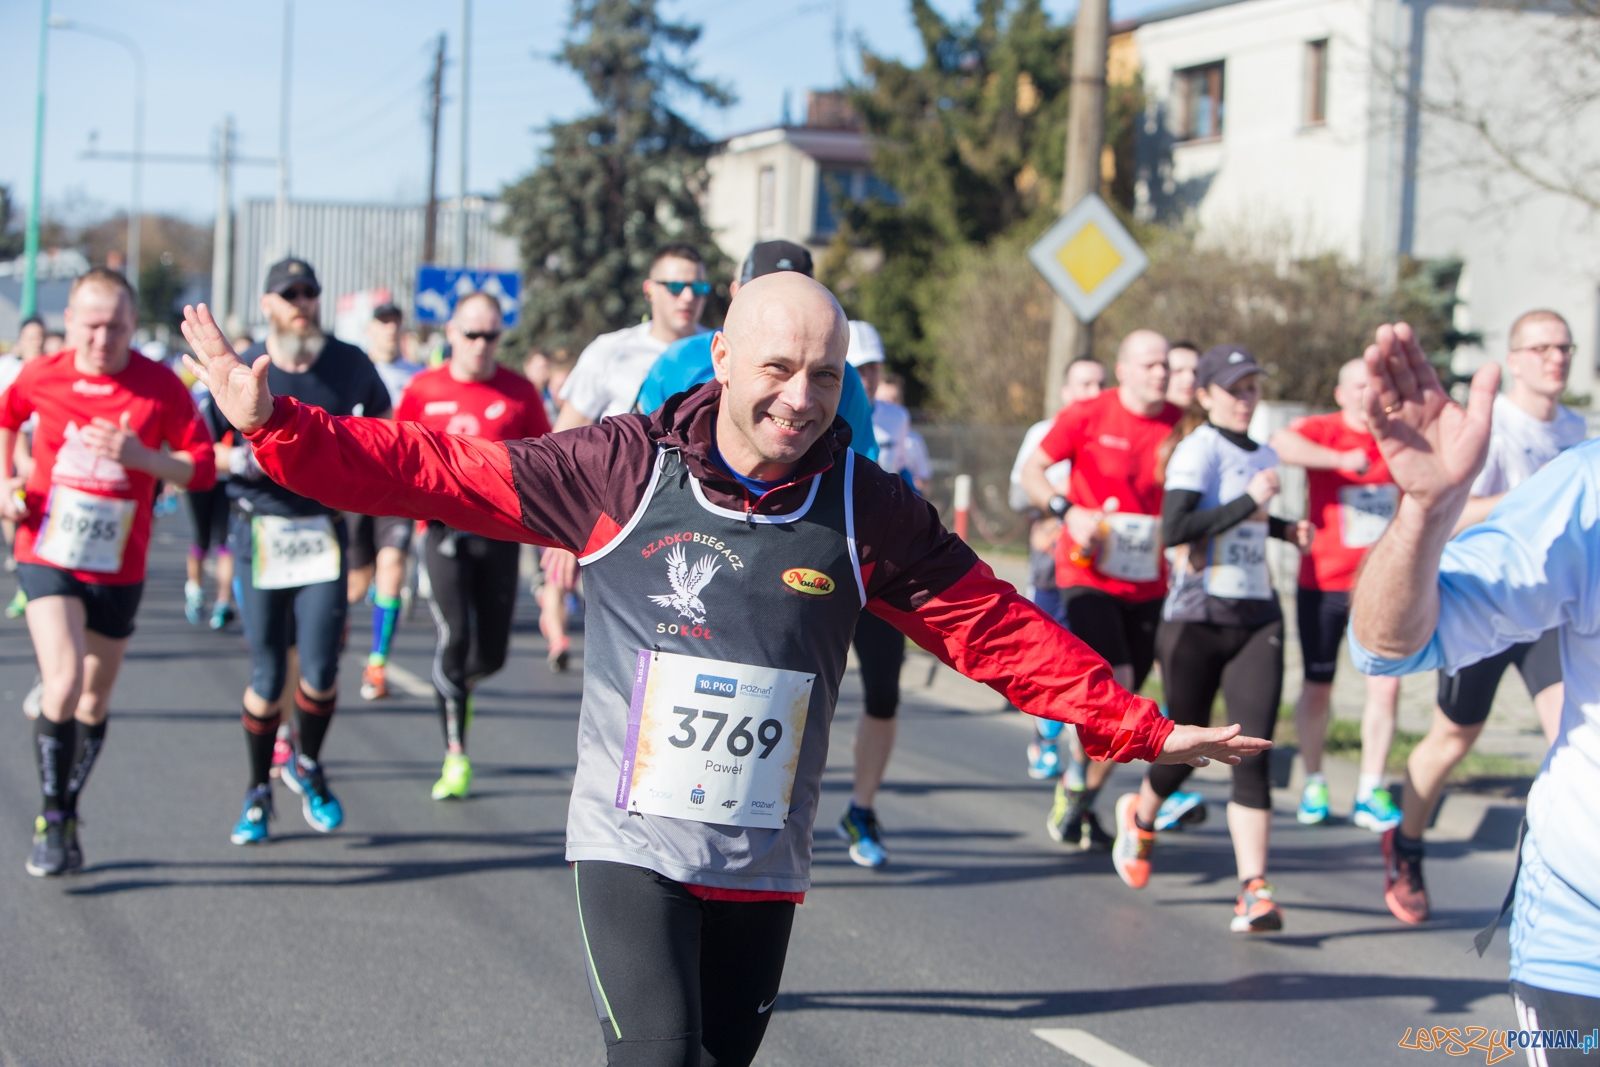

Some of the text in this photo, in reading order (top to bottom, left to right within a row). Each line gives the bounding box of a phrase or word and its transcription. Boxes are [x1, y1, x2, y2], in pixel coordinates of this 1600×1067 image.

[61, 512, 118, 541] 8955
[641, 531, 744, 572] SZADKOBIEGACZ
[656, 622, 713, 640] SOKÓŁ
[699, 680, 733, 692] 10. PKO
[668, 705, 783, 759] 3769
[705, 760, 743, 775] Paweł
[721, 800, 738, 809] 4F
